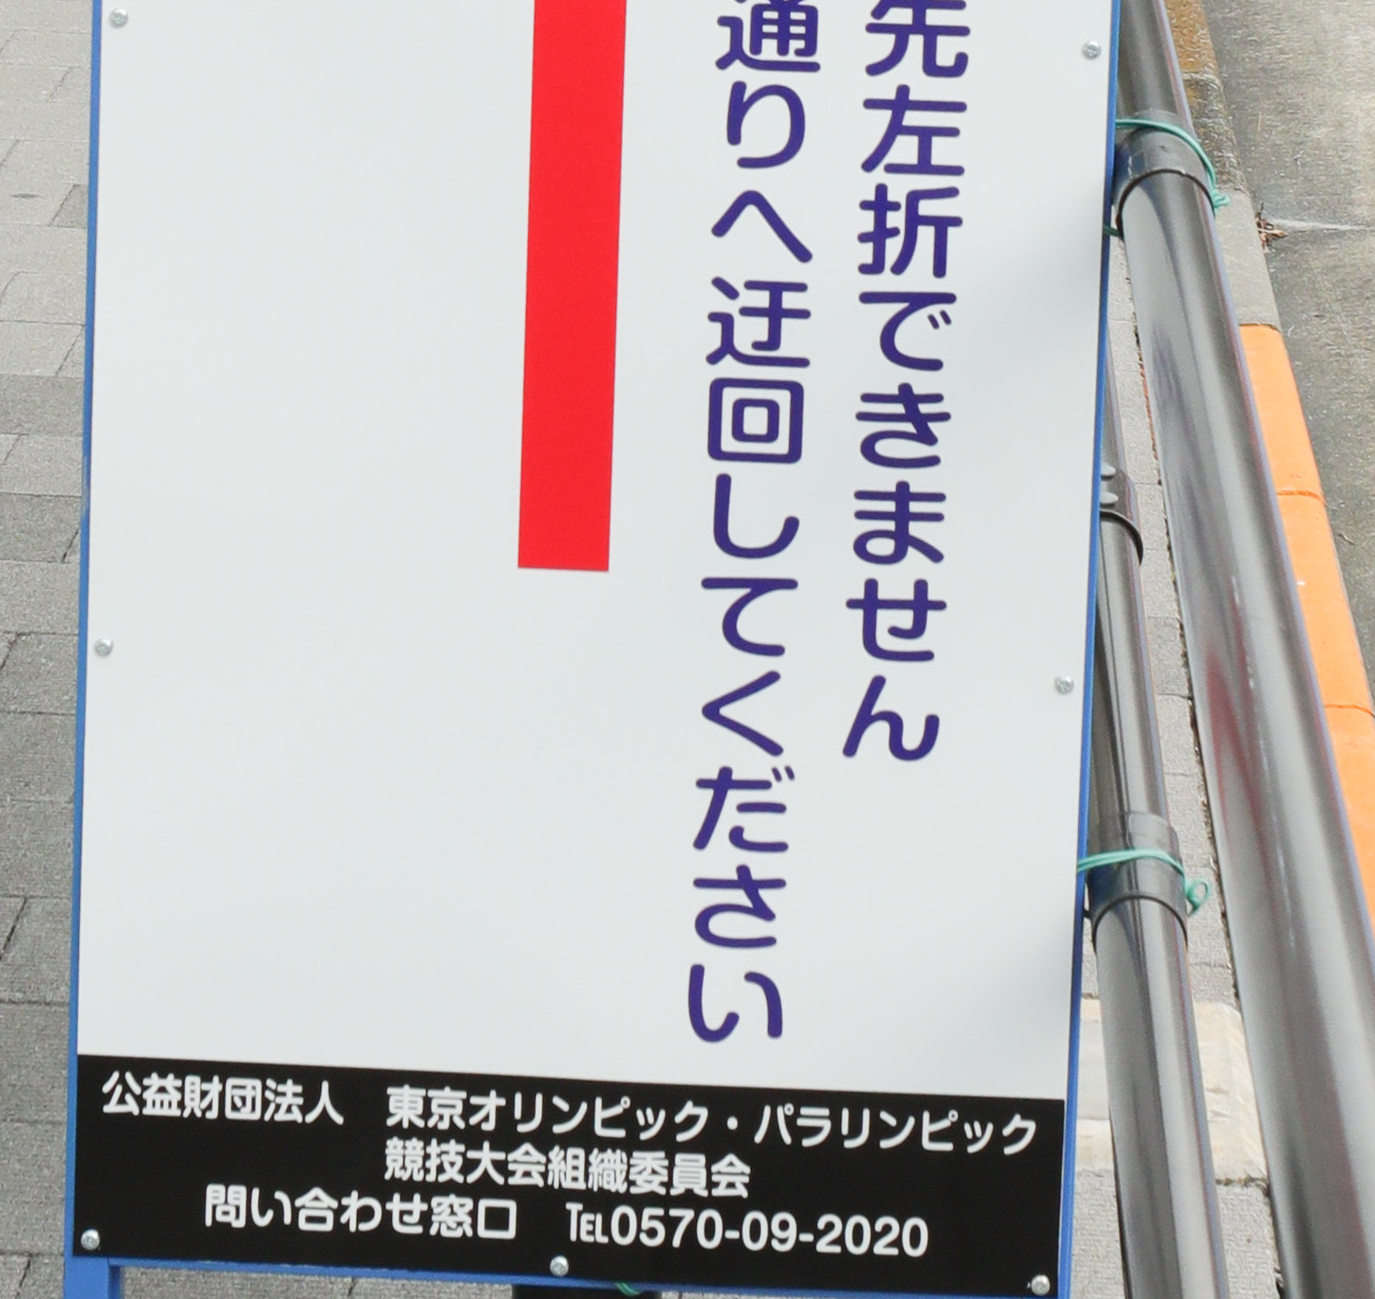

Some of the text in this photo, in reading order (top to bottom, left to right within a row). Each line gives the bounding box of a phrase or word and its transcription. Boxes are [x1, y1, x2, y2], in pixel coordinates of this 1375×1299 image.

[103, 1071, 1037, 1155] 公益財団法人 東京オリンピック・パラリンピック
[385, 1138, 751, 1198] 競技大会組織委員会
[204, 1184, 518, 1239] 問い合わせ窓口
